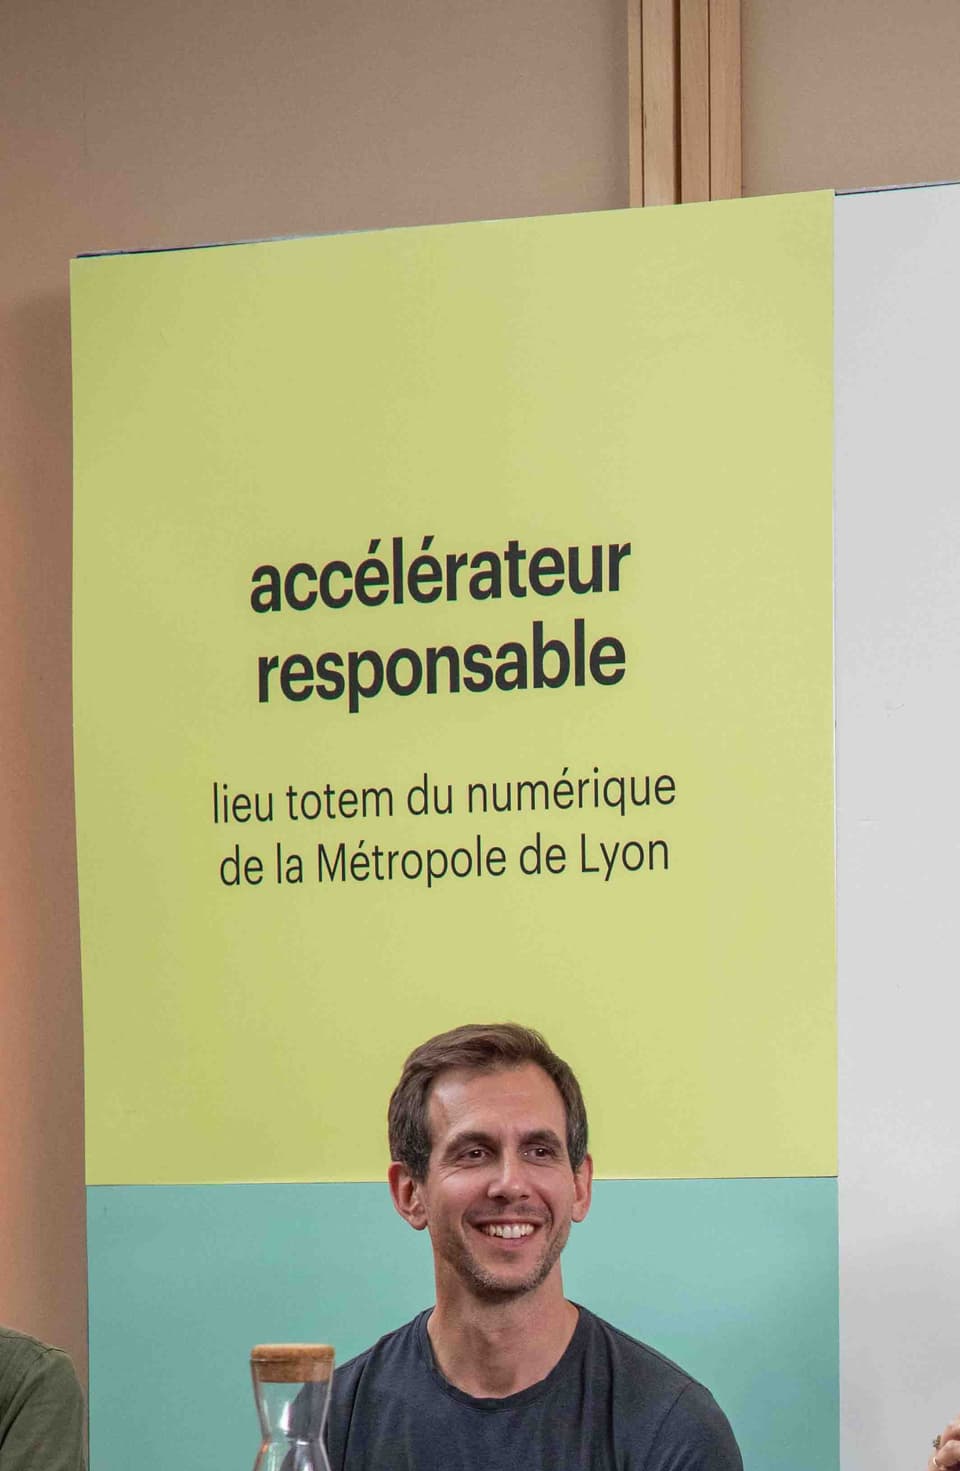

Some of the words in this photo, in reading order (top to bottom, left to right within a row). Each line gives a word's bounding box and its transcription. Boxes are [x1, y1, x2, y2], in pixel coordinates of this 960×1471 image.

[250, 534, 632, 614] accélérateur
[258, 617, 626, 714] responsable
[213, 781, 274, 824] lieu
[285, 783, 394, 821] totem
[407, 772, 453, 816] du
[468, 766, 676, 817] numérique
[219, 843, 264, 887] de
[276, 842, 304, 885] la
[317, 834, 507, 889] Métropole
[519, 831, 567, 876] de
[580, 832, 669, 882] Lyon
